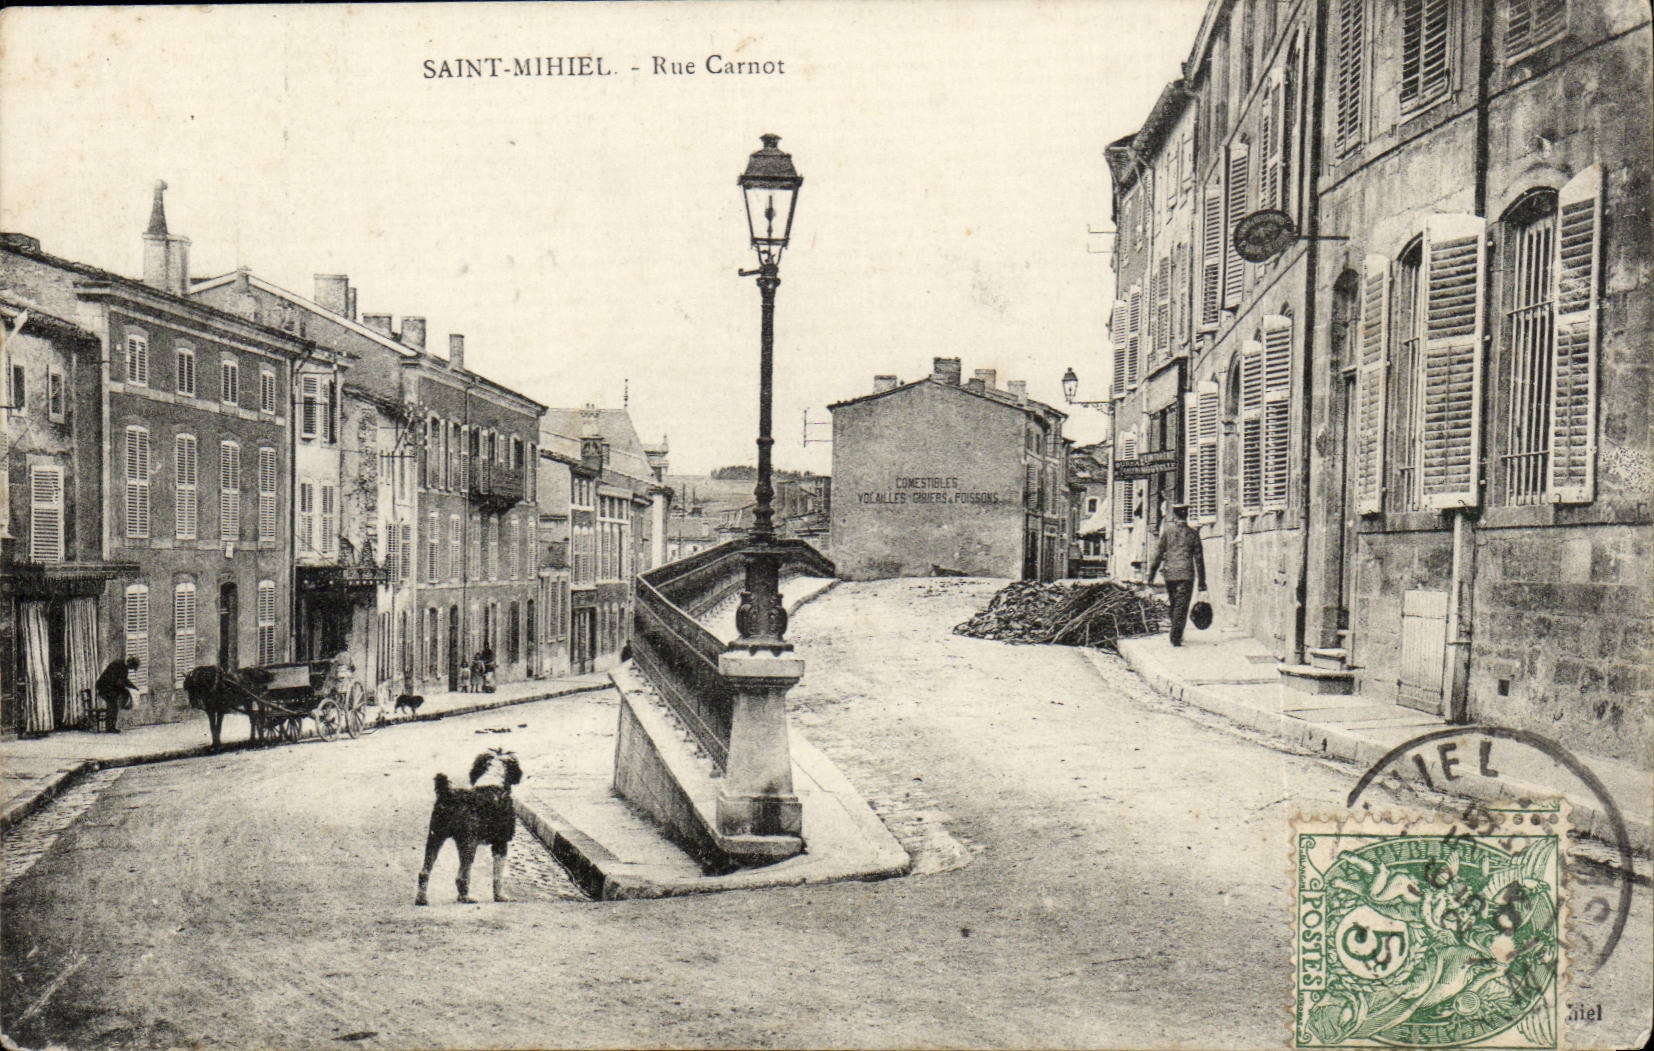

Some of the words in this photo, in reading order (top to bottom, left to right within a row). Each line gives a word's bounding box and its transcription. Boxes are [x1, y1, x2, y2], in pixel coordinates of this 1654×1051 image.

[895, 477, 958, 489] COMESTIBLES
[858, 492, 906, 504] VOLAILLES
[955, 492, 999, 504] POISSONS
[1302, 894, 1323, 986] POSTES
